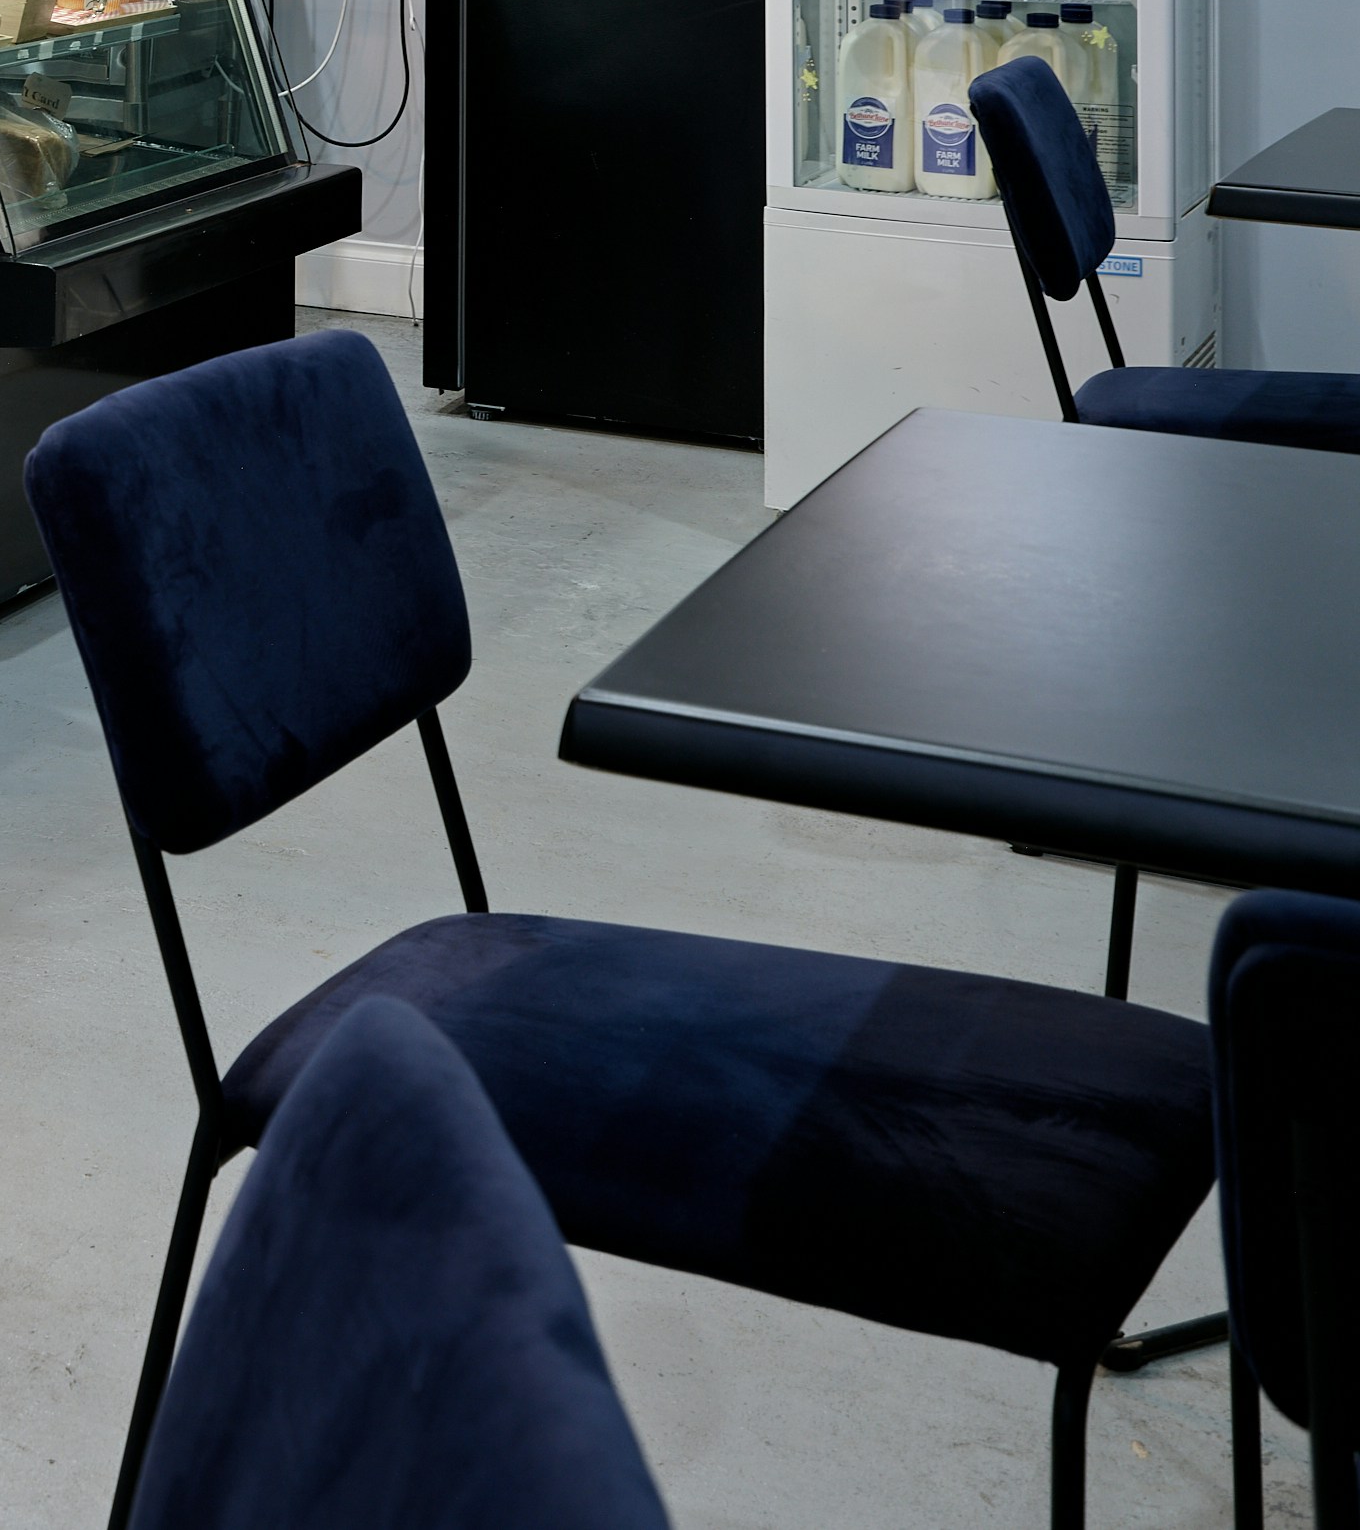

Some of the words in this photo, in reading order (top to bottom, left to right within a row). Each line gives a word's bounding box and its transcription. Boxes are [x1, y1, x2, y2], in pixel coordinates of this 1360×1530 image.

[32, 91, 60, 109] Card
[855, 143, 880, 153] FARM
[856, 151, 879, 160] MILK
[935, 150, 961, 160] FARM
[936, 159, 960, 168] MILK
